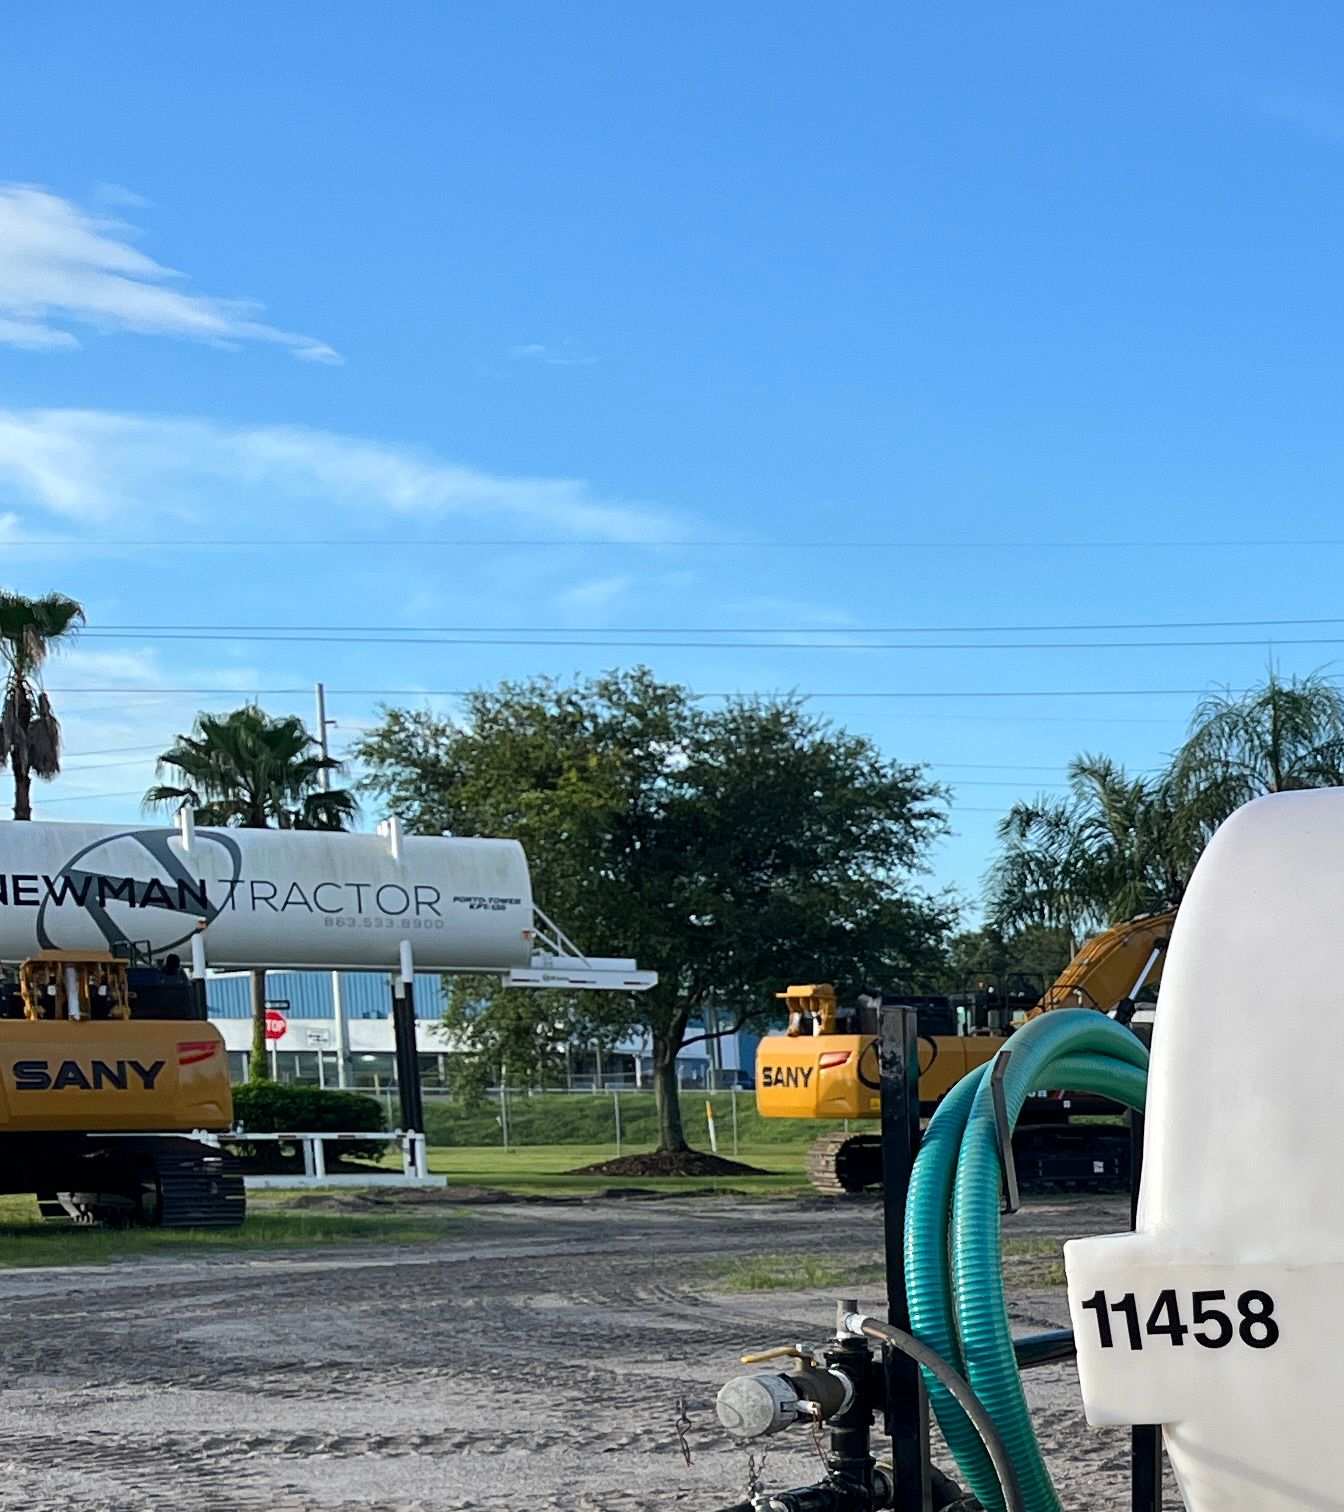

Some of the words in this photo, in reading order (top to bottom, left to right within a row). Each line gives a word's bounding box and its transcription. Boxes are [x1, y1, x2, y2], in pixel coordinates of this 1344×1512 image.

[0, 874, 442, 917] EWMANTRACTOR
[12, 1060, 166, 1090] SANY
[762, 1066, 816, 1088] SANY
[1082, 1289, 1280, 1351] 11458
